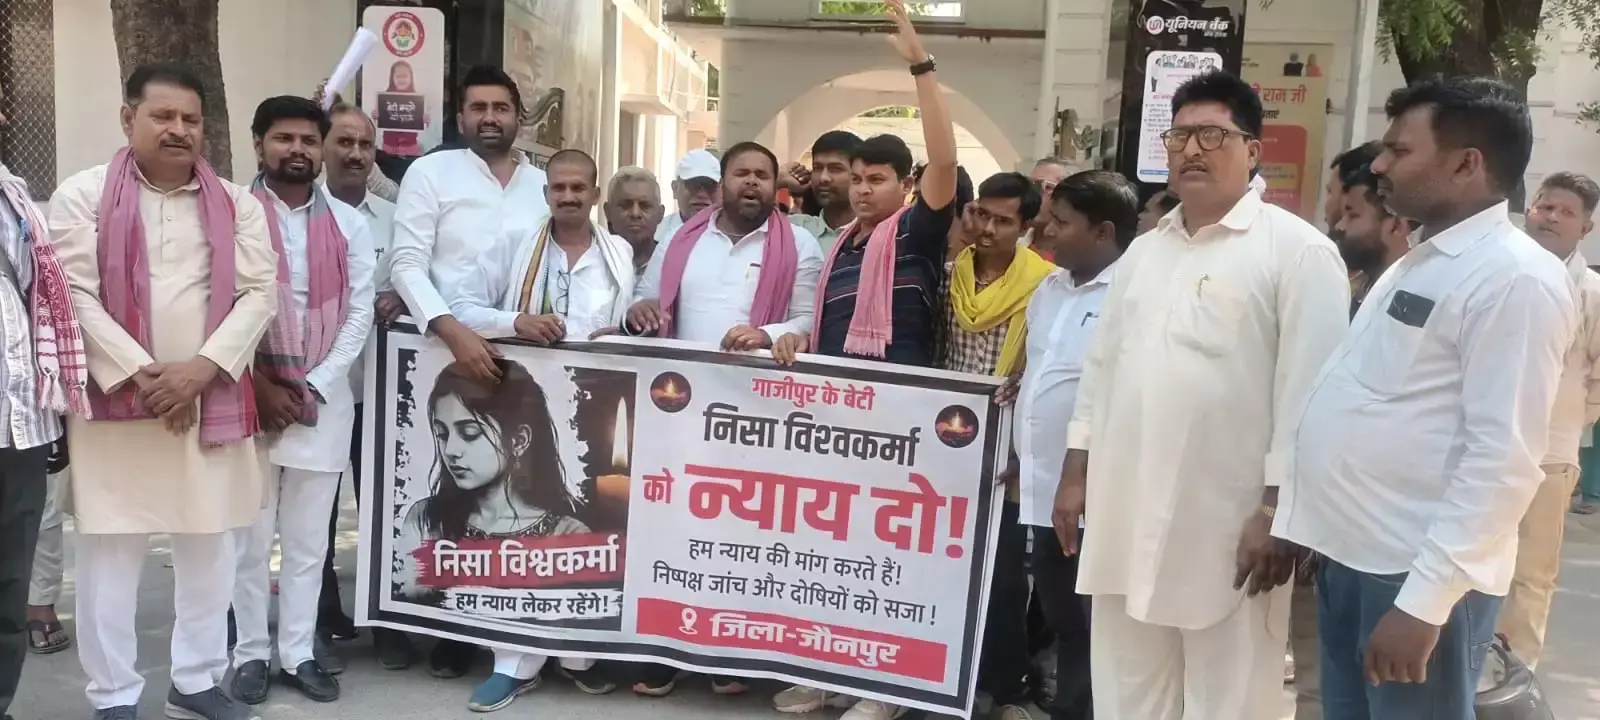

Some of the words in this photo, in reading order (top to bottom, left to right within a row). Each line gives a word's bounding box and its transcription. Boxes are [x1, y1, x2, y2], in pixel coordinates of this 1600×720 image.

[1164, 15, 1208, 33] यूनियन
[1289, 84, 1308, 104] जी
[752, 376, 818, 408] गाजीपुर
[821, 381, 841, 405] के
[843, 384, 876, 410] बेटी
[703, 402, 779, 448] निसा
[784, 411, 921, 467] विश्वकर्मा
[642, 467, 674, 504] को
[684, 463, 861, 541] न्याय
[433, 539, 492, 577] निसा
[498, 534, 620, 577] विश्वकर्मा
[689, 538, 714, 560] हम
[719, 542, 761, 564] न्याय
[766, 542, 790, 567] की
[795, 548, 829, 574] मांग
[833, 556, 877, 581] करते
[456, 592, 478, 610] हम
[482, 594, 517, 612] न्याय
[522, 592, 563, 614] लेकर
[653, 559, 704, 592] निष्पक्ष
[708, 570, 748, 595] जांच
[752, 572, 786, 599] और
[790, 579, 850, 610] दोषियों
[854, 589, 879, 615] को
[884, 598, 925, 625] सजा
[708, 611, 901, 668] जिला-जौनपुर
